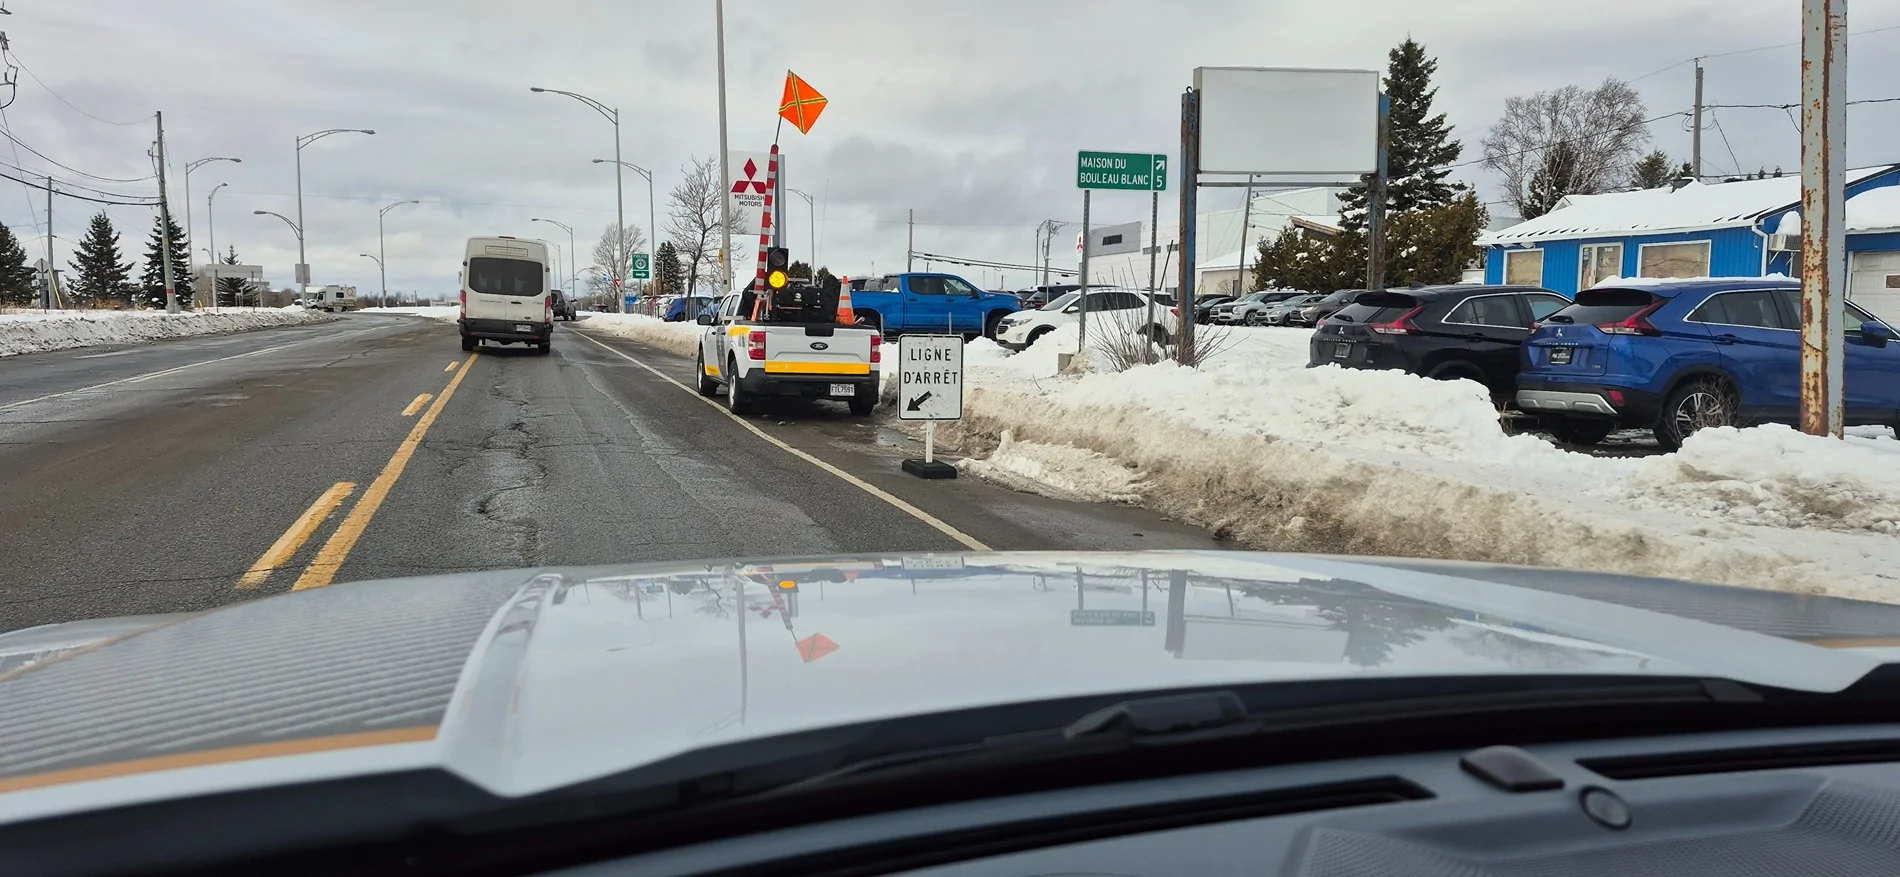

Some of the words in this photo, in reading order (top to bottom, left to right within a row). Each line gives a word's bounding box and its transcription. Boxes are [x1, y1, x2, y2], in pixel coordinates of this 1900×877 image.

[1081, 157, 1113, 169] MAISON
[1115, 158, 1127, 169] DU
[1081, 173, 1119, 184] BOULEAU
[1121, 174, 1149, 185] BLANC
[1156, 175, 1163, 188] 5
[910, 348, 952, 361] LIGNE
[904, 369, 958, 384] D'ARRÊT
